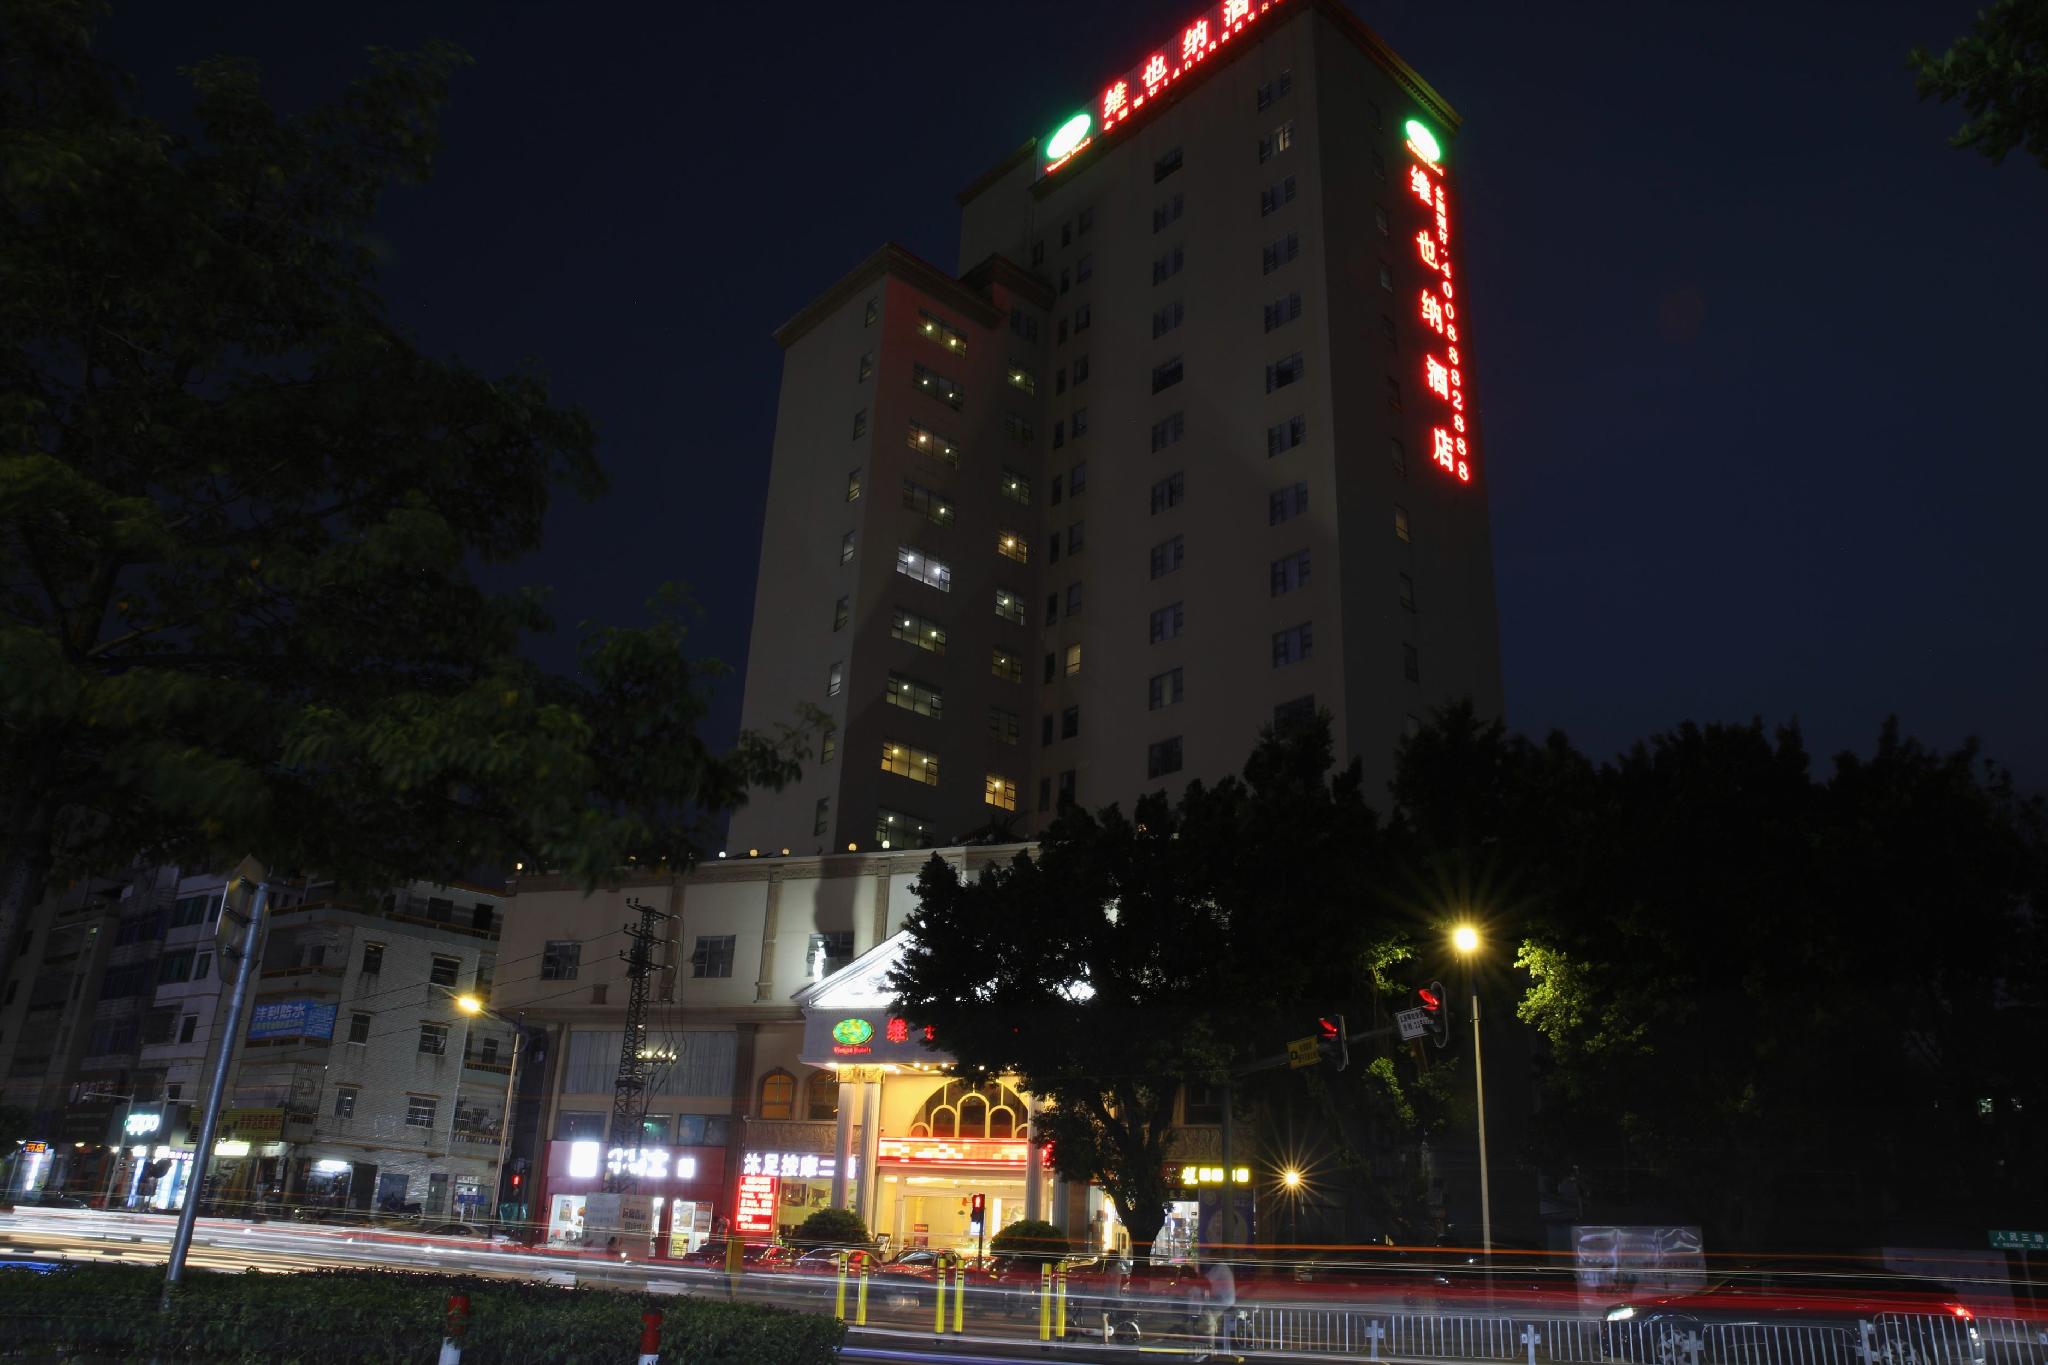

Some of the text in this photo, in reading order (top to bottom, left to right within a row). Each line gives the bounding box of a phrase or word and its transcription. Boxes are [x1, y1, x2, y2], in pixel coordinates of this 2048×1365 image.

[1410, 164, 1454, 472] 维也纳酒店
